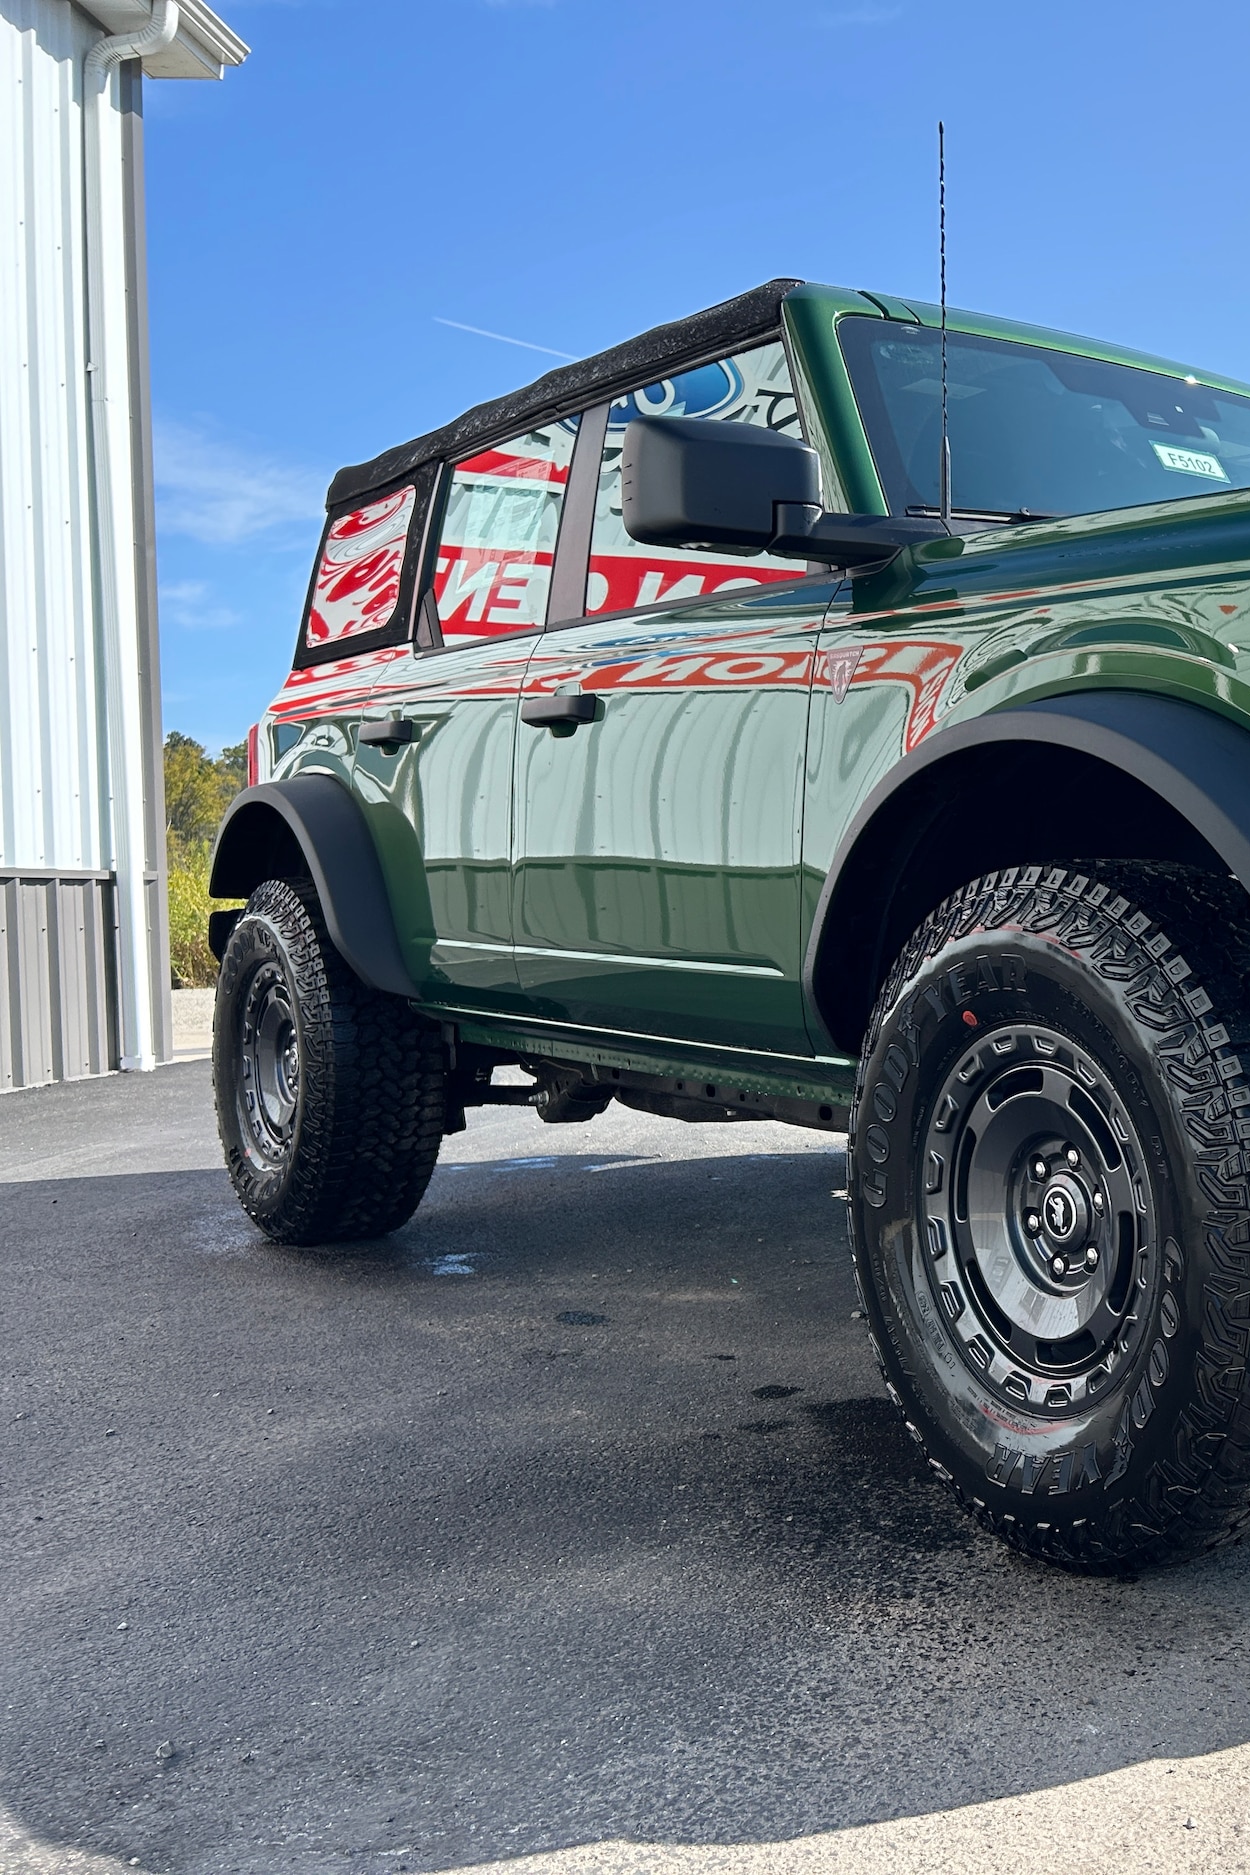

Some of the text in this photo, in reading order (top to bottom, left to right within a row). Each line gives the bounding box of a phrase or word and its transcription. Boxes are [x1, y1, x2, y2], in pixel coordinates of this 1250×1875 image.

[1168, 452, 1216, 475] F5102
[829, 650, 860, 660] SASQUATCH
[862, 953, 1028, 1208] GOODYEAR
[986, 1235, 1184, 1495] GOODYEAR
